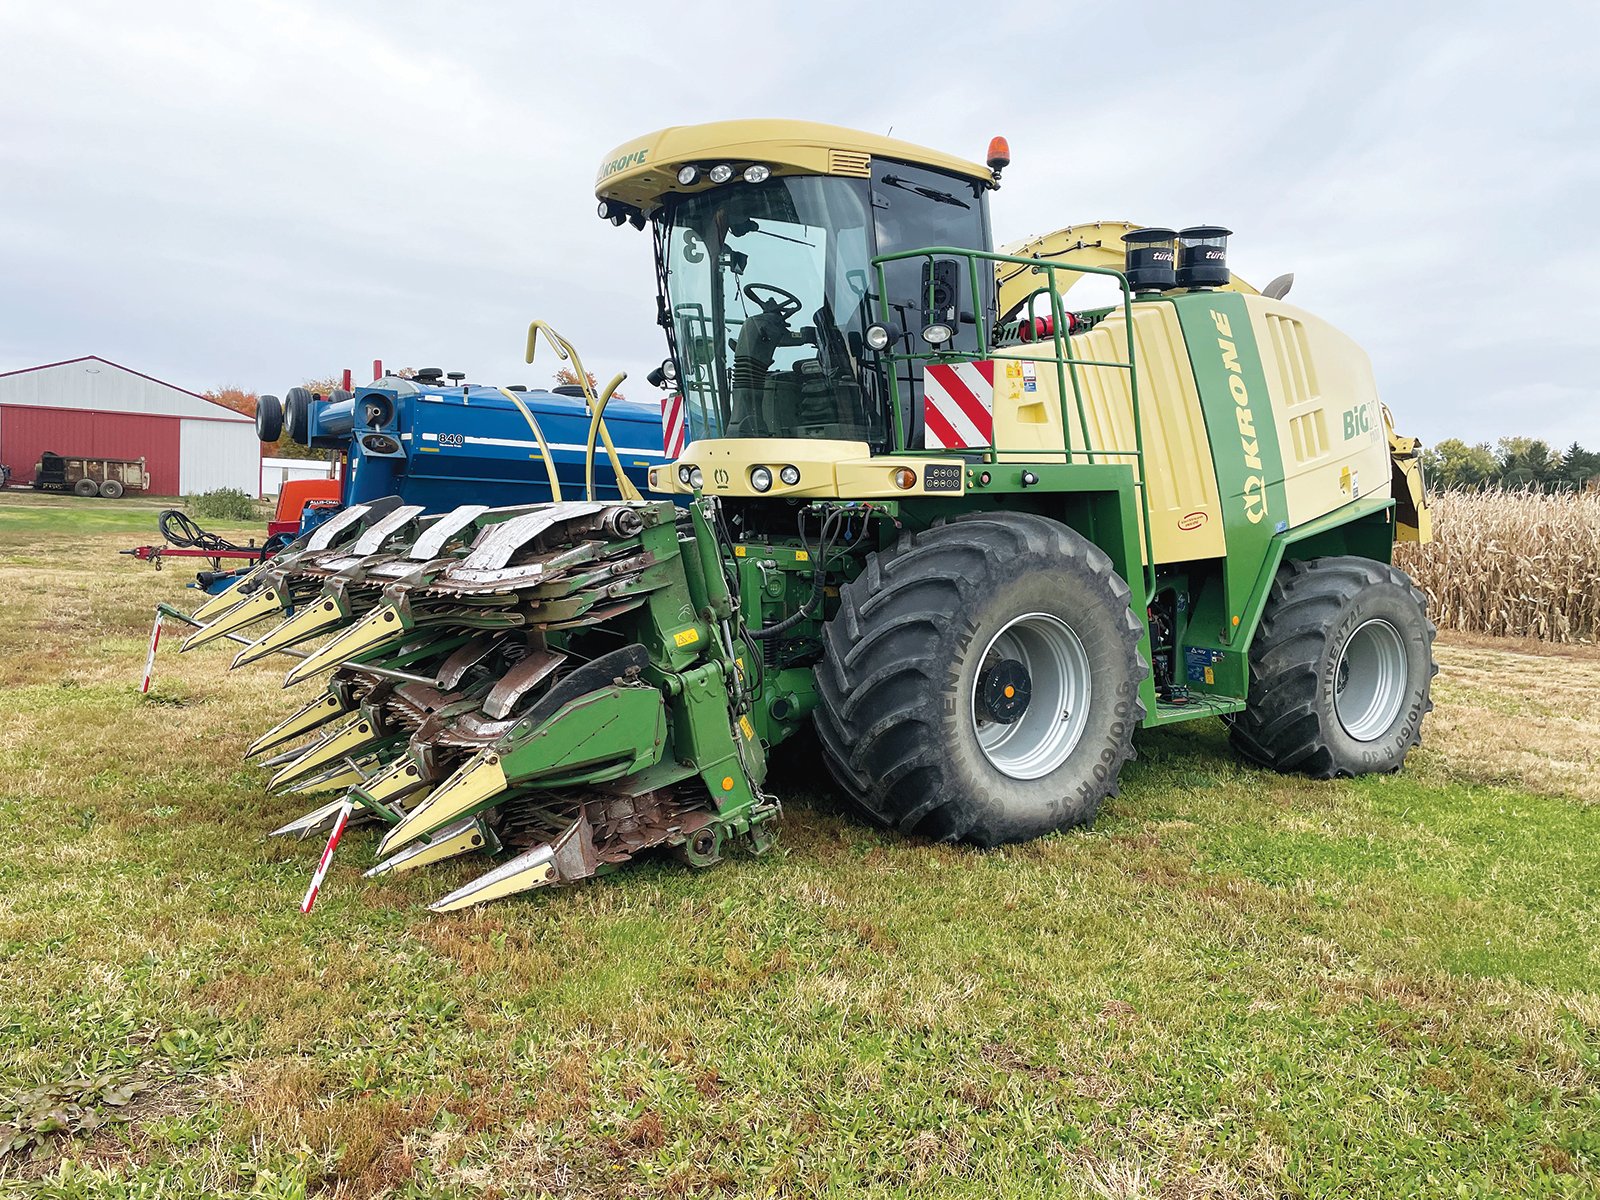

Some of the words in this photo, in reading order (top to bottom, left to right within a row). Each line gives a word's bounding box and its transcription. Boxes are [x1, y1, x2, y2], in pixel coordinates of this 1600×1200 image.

[603, 149, 649, 178] KRONE
[1209, 309, 1263, 470] KRONE
[438, 433, 464, 444] 840
[1092, 680, 1130, 783] 900/60
[1395, 688, 1425, 749] 710/60
[1362, 750, 1380, 764] 30
[1383, 746, 1396, 761] R
